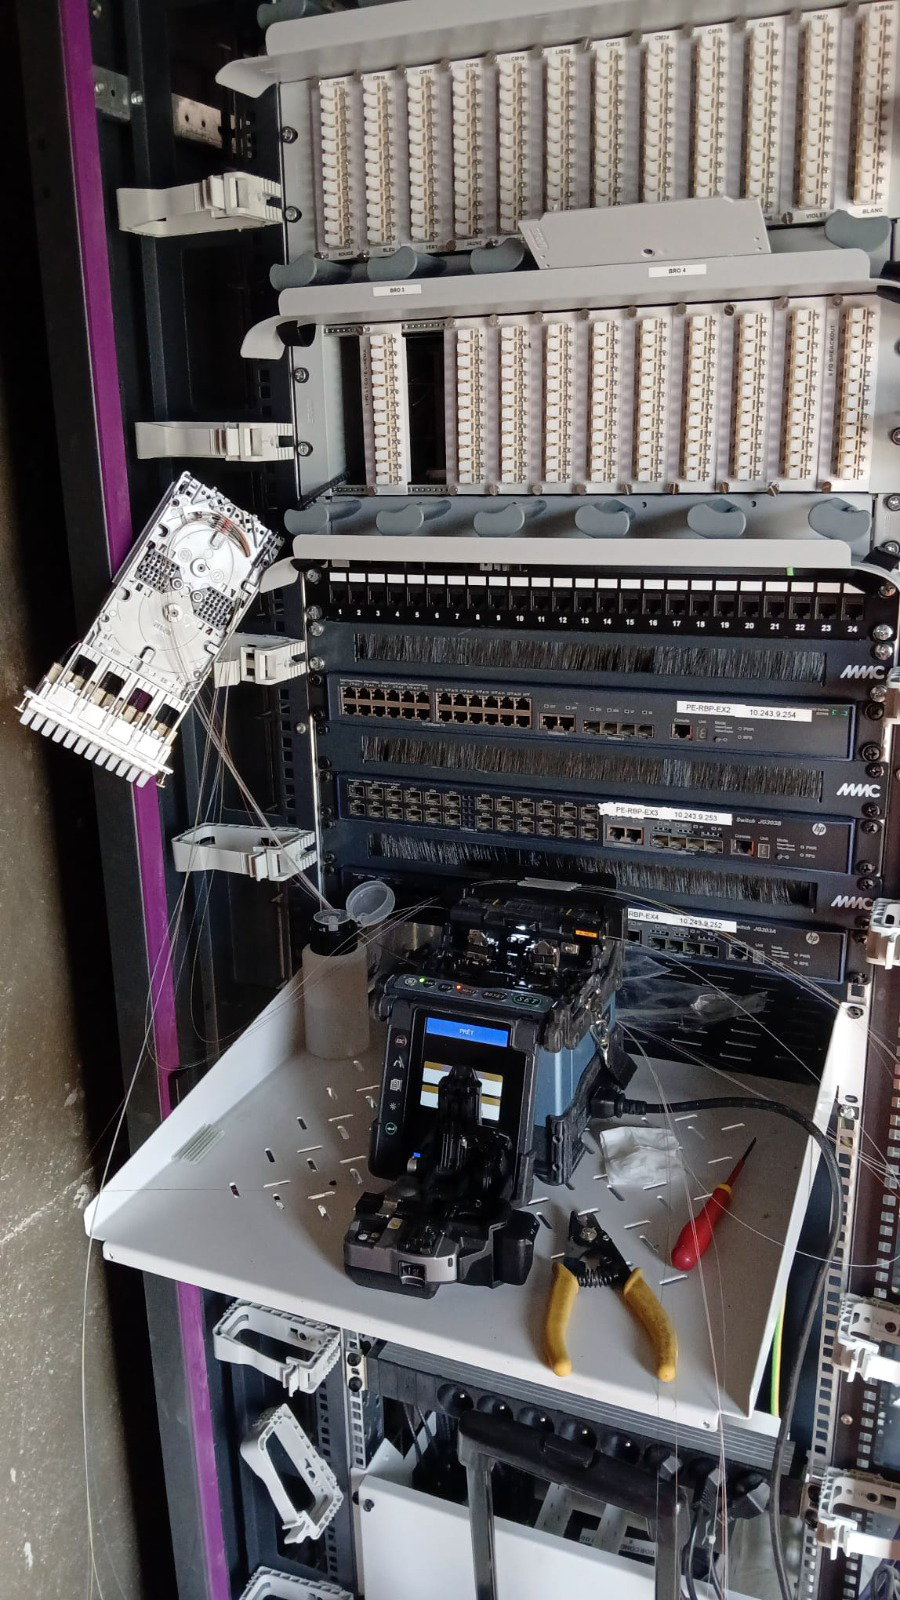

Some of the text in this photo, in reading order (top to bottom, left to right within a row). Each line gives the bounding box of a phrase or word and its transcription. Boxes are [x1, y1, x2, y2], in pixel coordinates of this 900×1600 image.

[686, 704, 796, 719] PE-RBP-EX2 10.243.9.254
[616, 807, 718, 821] PE-RBP-EX3 10.243.9.253
[813, 823, 826, 835] hp
[806, 932, 819, 944] hp
